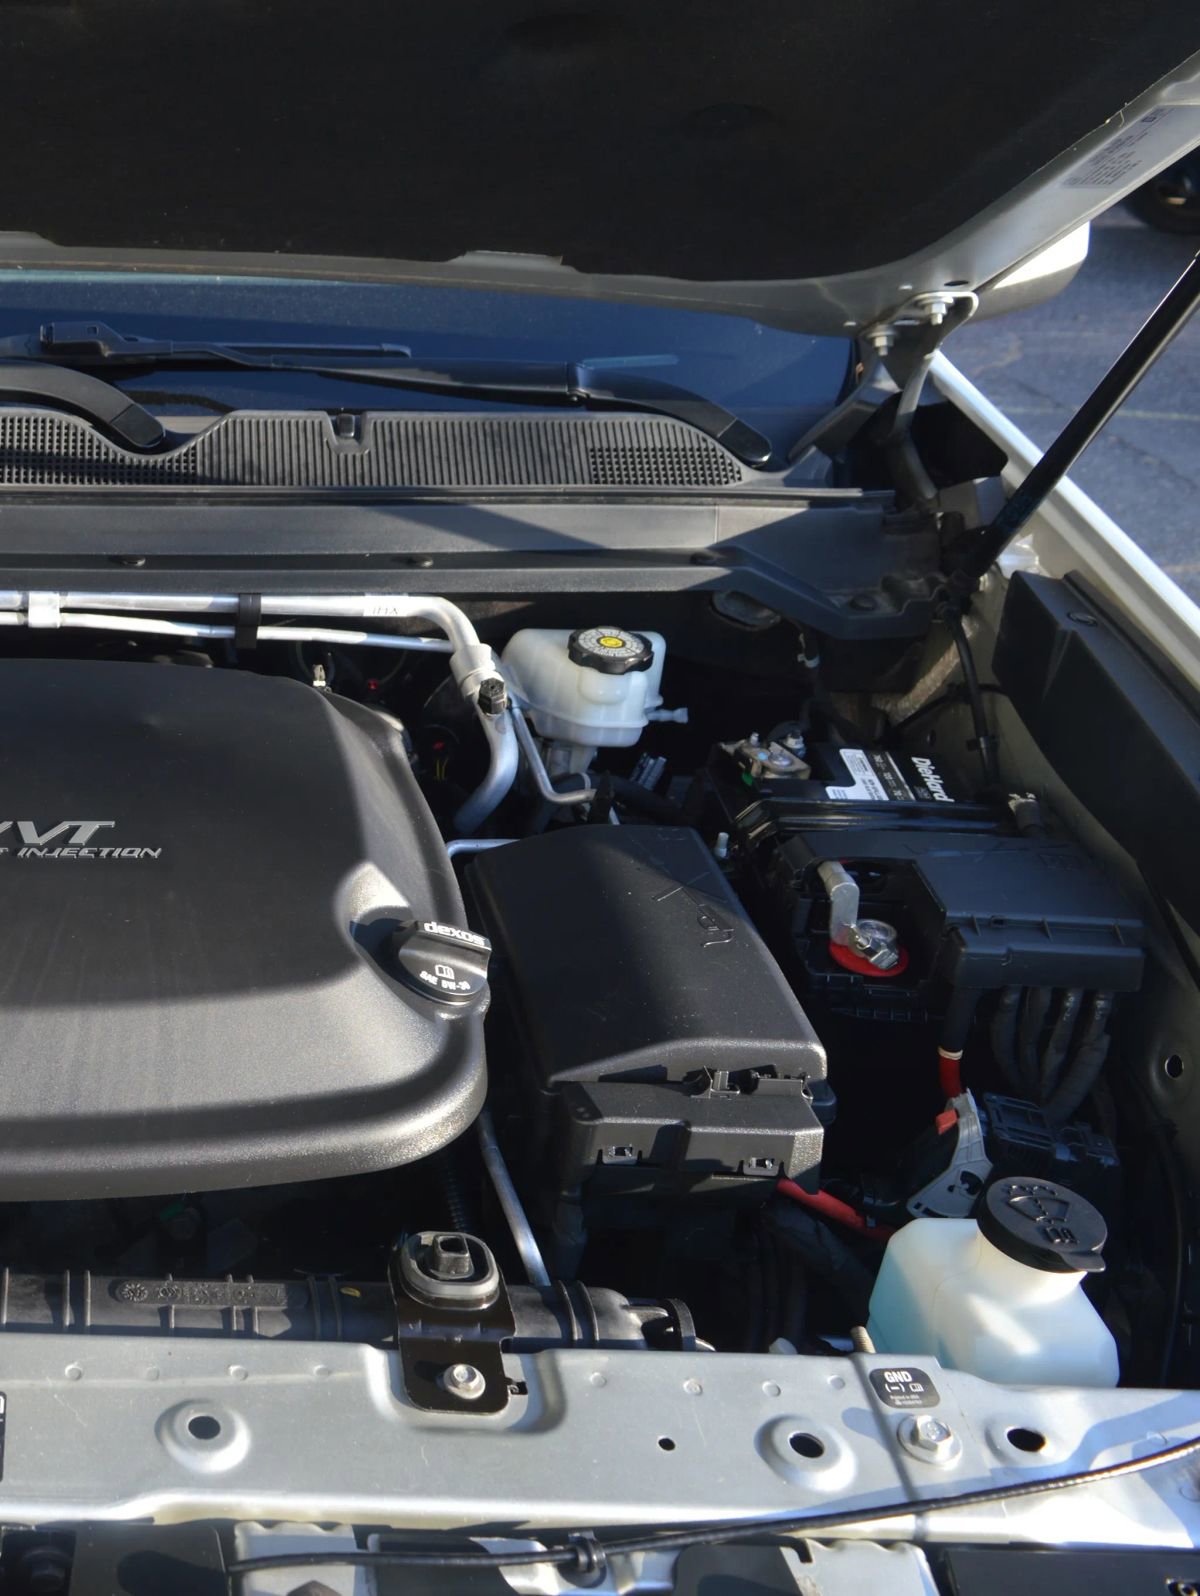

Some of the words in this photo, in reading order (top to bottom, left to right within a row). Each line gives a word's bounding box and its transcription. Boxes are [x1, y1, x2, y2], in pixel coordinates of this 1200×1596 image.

[911, 756, 955, 802] DieHard
[16, 846, 163, 859] INJECTION
[423, 921, 485, 946] dexos
[884, 1370, 913, 1383] GND
